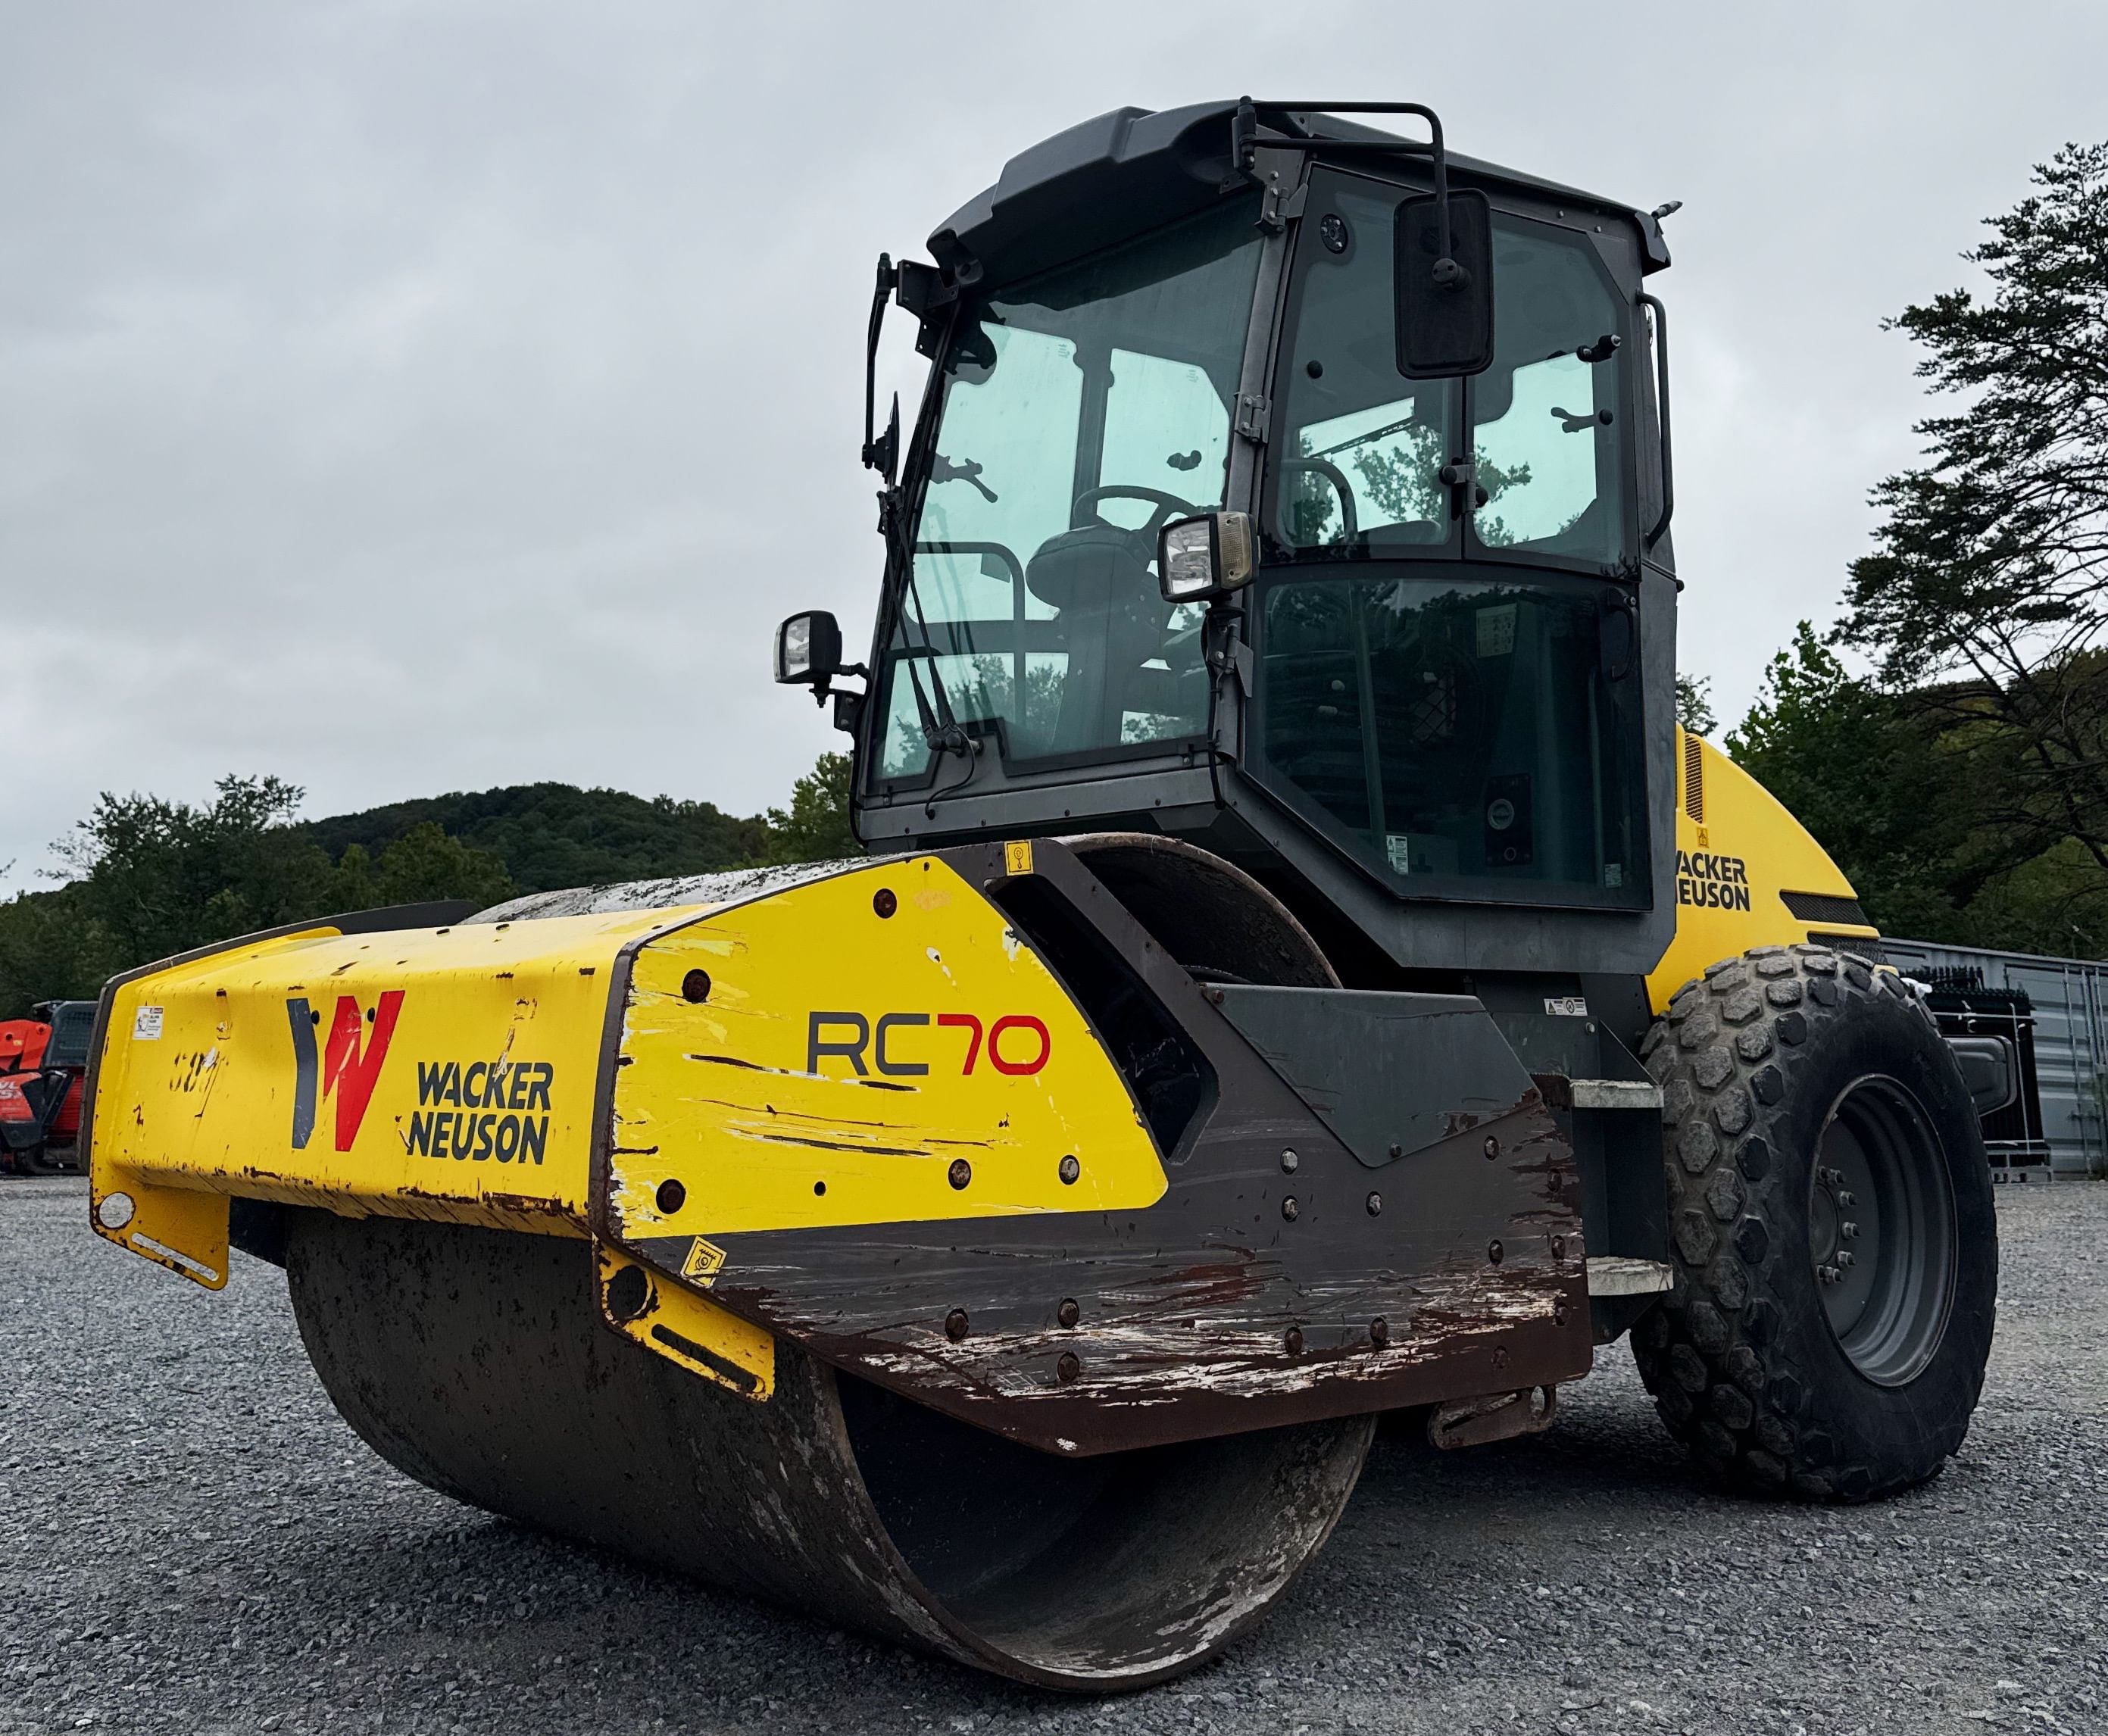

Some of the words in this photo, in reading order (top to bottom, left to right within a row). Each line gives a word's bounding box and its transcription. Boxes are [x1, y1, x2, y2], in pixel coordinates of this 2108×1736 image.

[1675, 876, 1750, 911] EUSON
[807, 1011, 1051, 1076] RC70
[418, 1061, 553, 1110] WACKER
[407, 1111, 549, 1165] NEUSON
